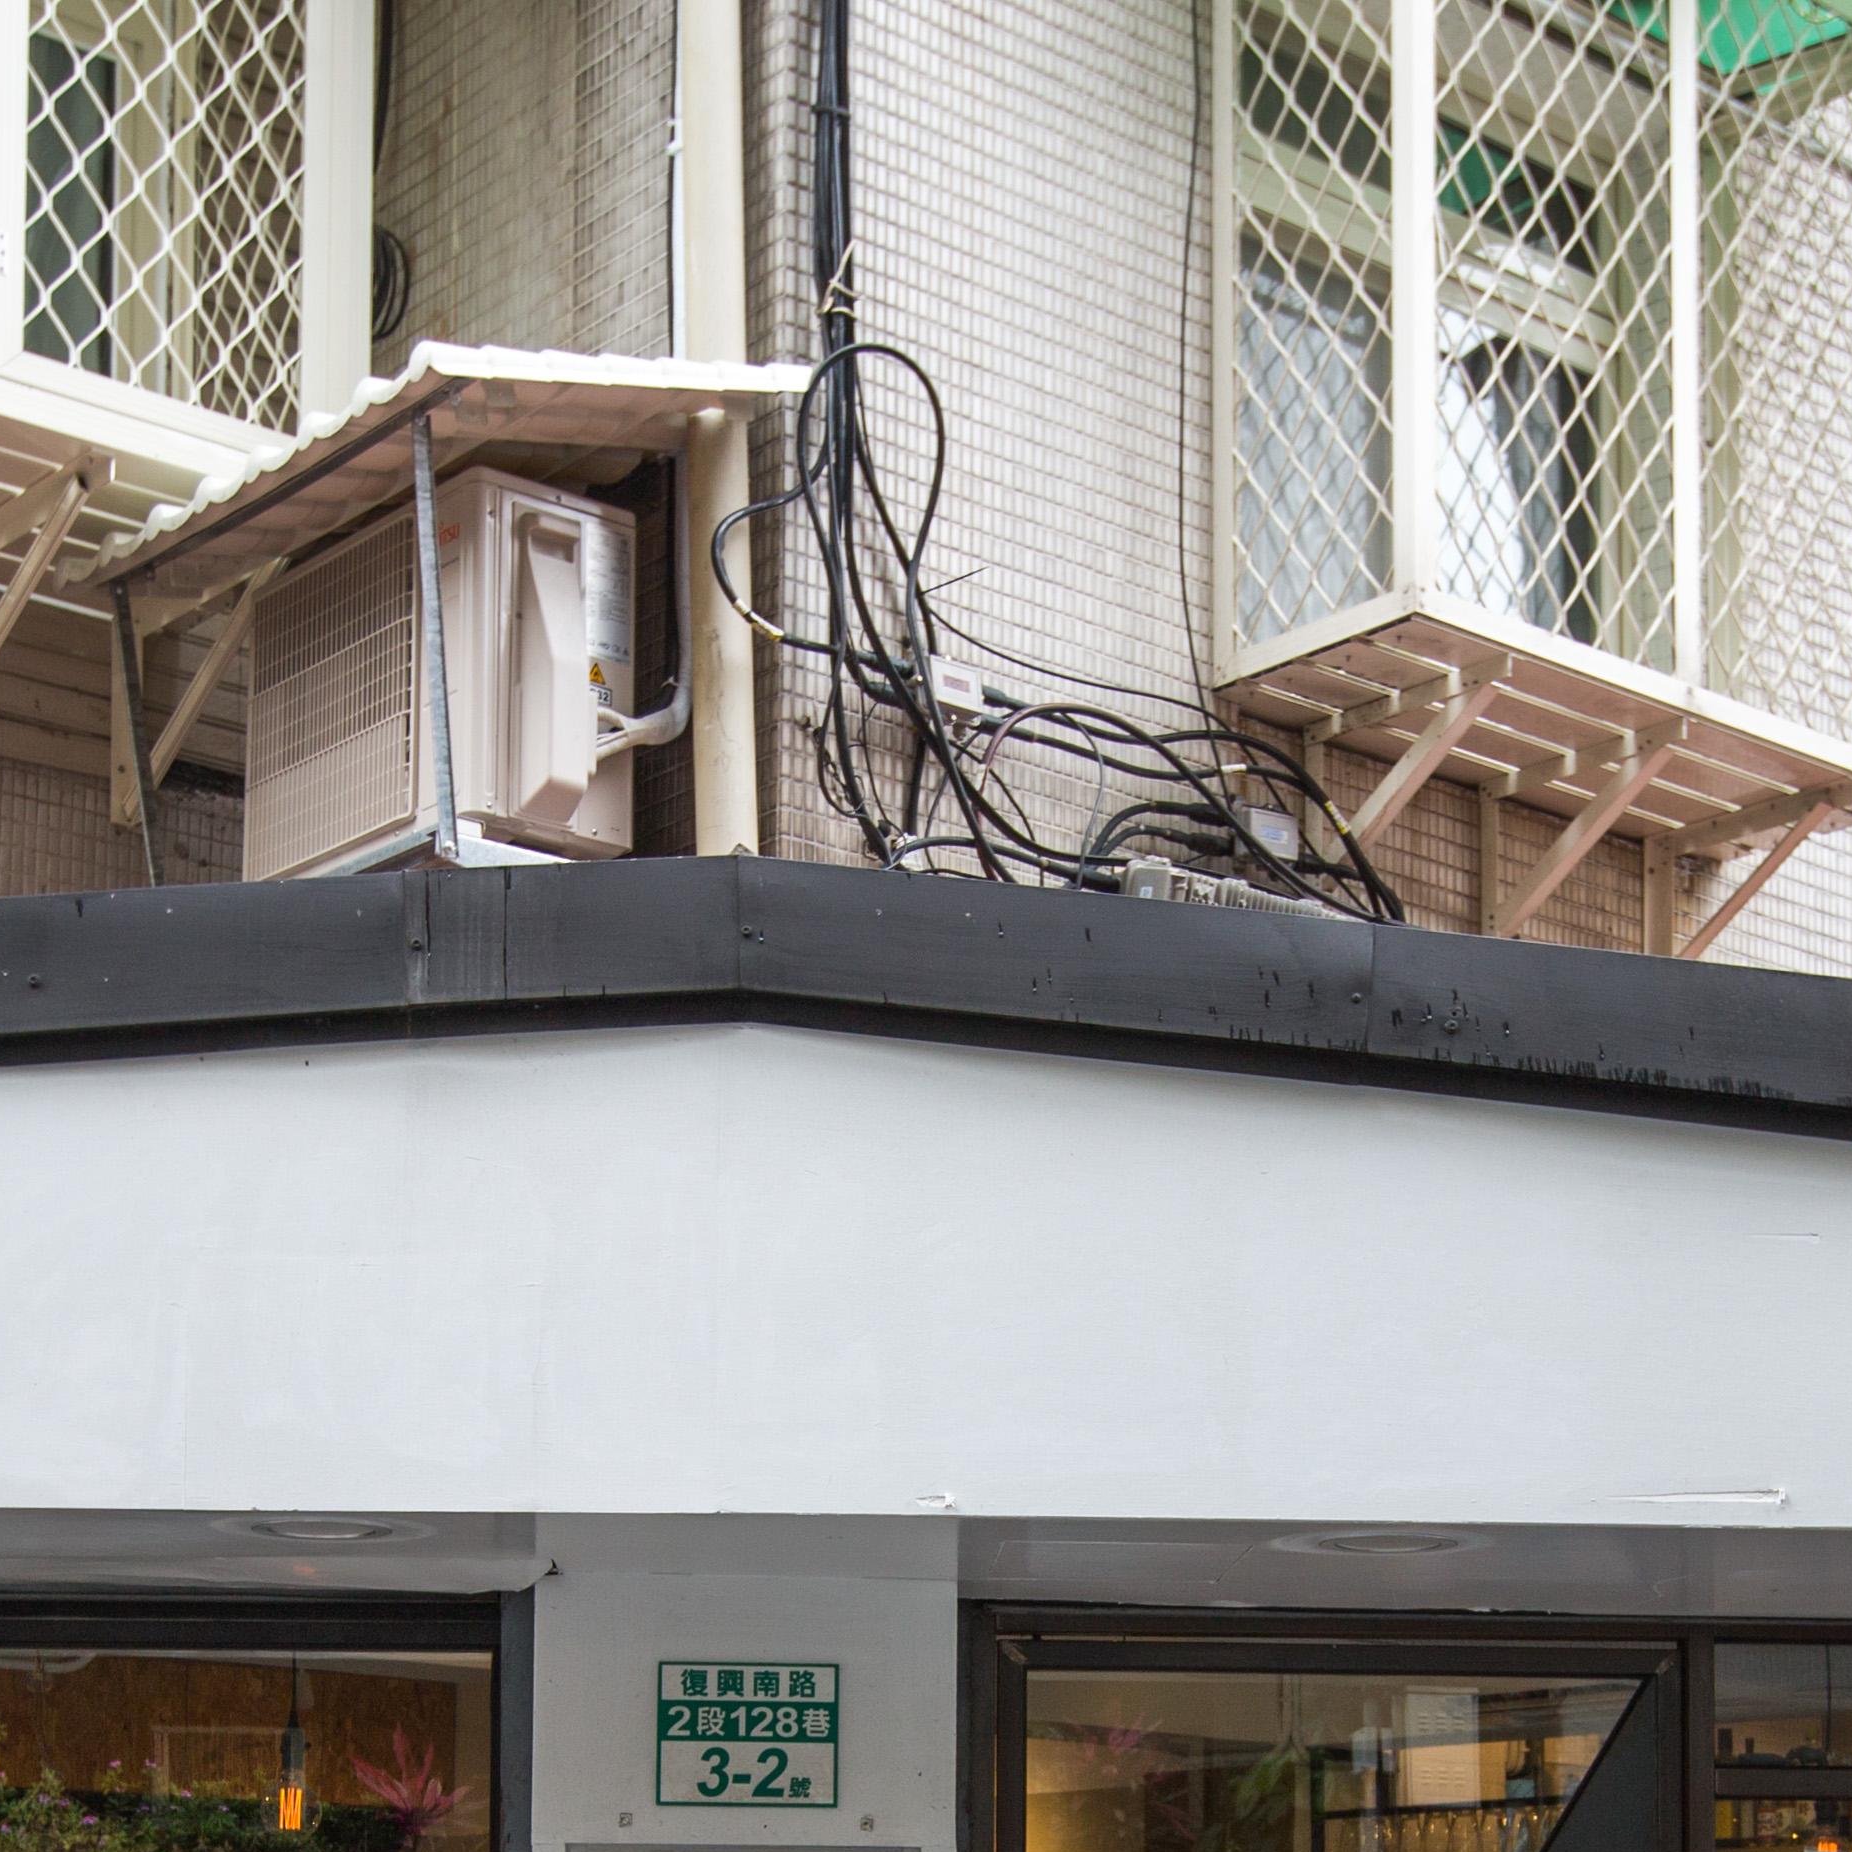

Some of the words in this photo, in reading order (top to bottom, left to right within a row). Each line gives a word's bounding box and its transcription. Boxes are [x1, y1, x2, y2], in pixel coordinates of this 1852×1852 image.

[681, 1669, 816, 1699] 復興南路
[666, 1705, 831, 1738] 2段128巷
[696, 1746, 812, 1799] 3-2號
